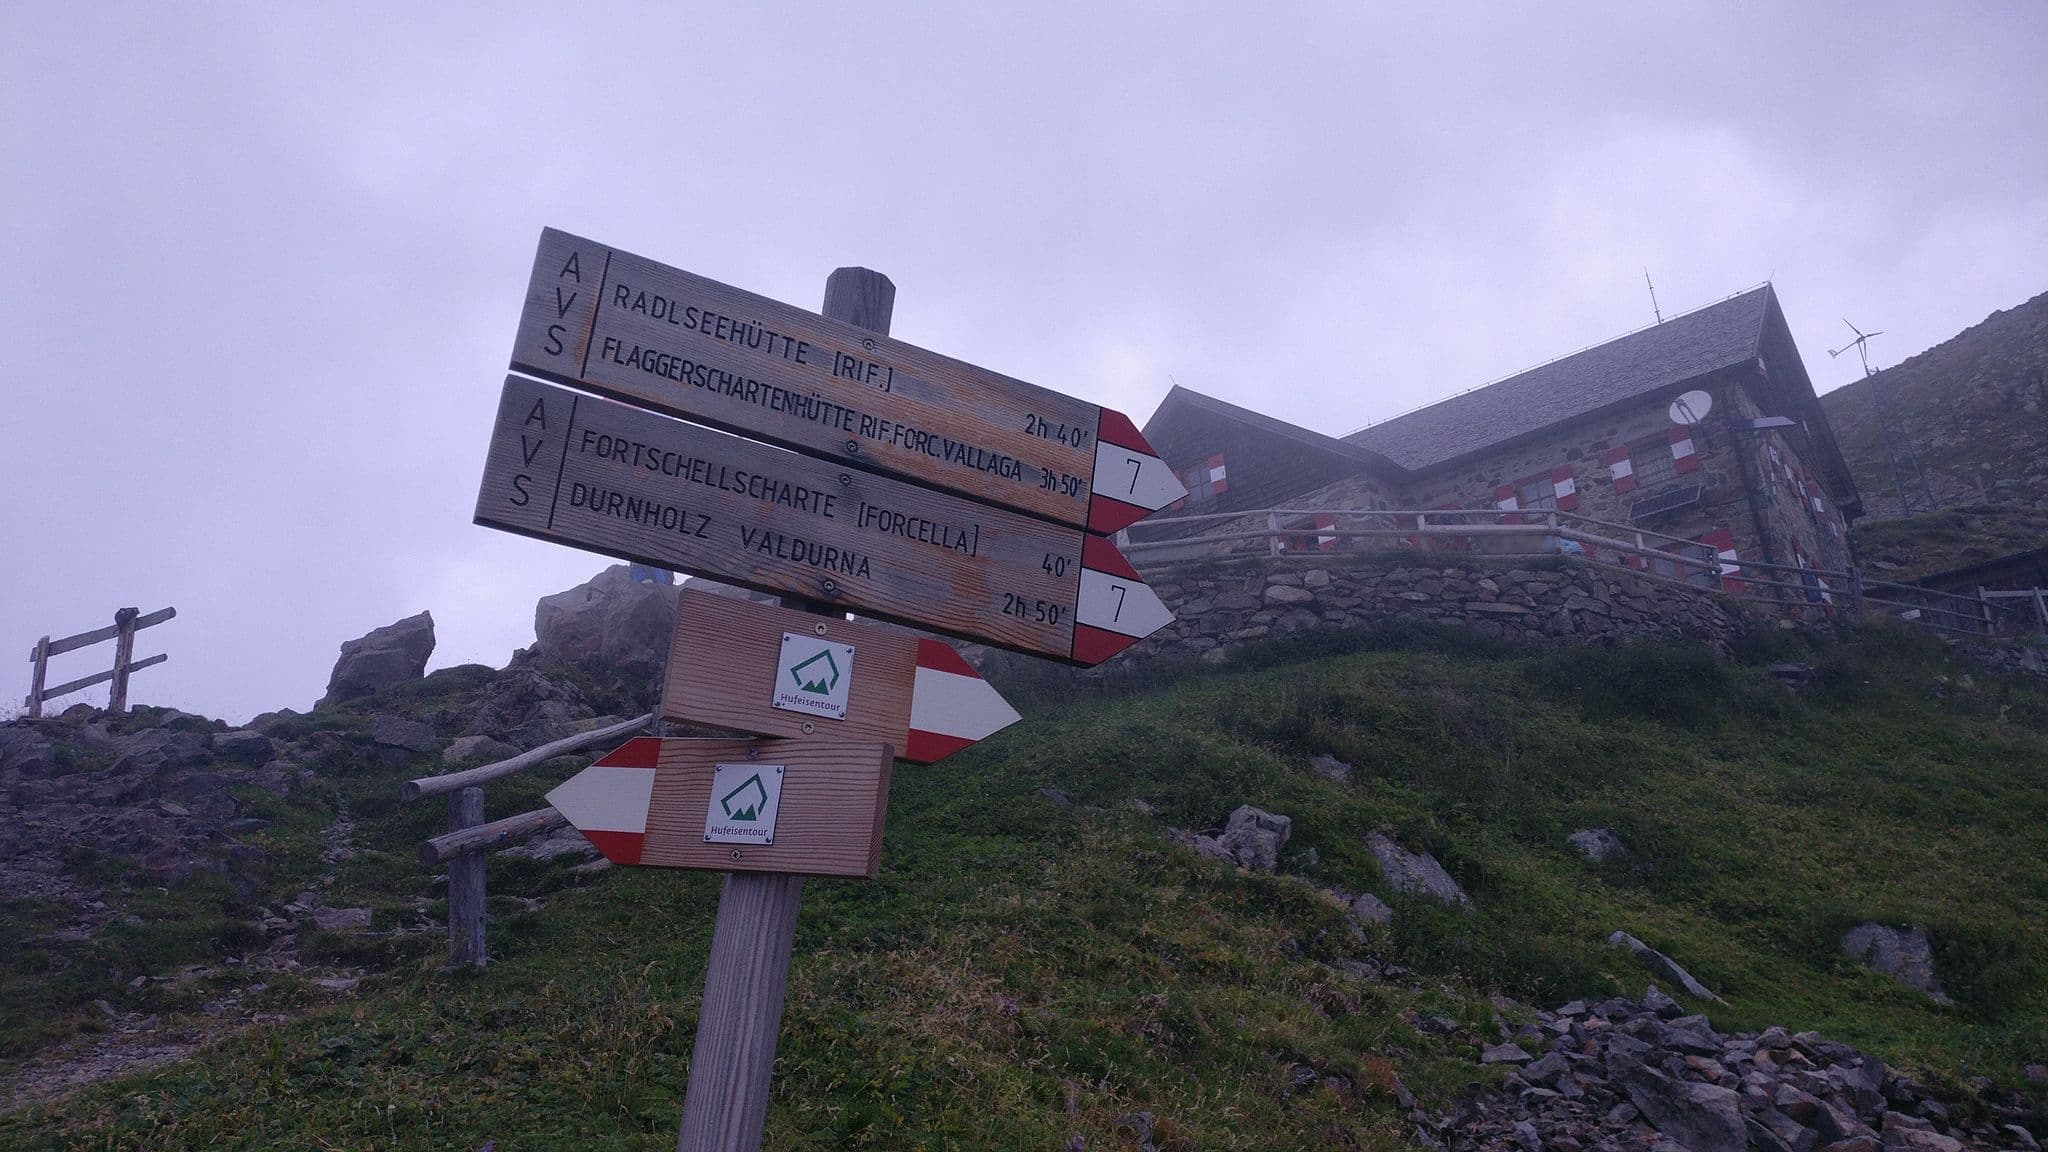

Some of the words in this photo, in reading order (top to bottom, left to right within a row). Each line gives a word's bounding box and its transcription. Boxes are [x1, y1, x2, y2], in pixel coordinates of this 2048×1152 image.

[544, 251, 582, 356] AVS
[613, 284, 810, 365] RADLSEEHÜTTE
[833, 350, 893, 392] [RIF.]
[601, 336, 855, 433] FLAGGERSCHARTENHÜTTE
[1025, 413, 1048, 439] 2h
[509, 398, 546, 506] AVS
[581, 429, 836, 518] FORTSCHELLSCHARTE
[857, 501, 980, 557] [FORCELLA]
[1039, 467, 1057, 491] 3h
[1126, 458, 1142, 495] 7
[569, 482, 712, 540] DURNHOLZ
[739, 524, 872, 580] VALDURNA
[1002, 593, 1026, 618] 2h
[1110, 584, 1126, 623] 7
[780, 693, 841, 712] Hufeisentour
[710, 825, 768, 837] Hufeisentour
